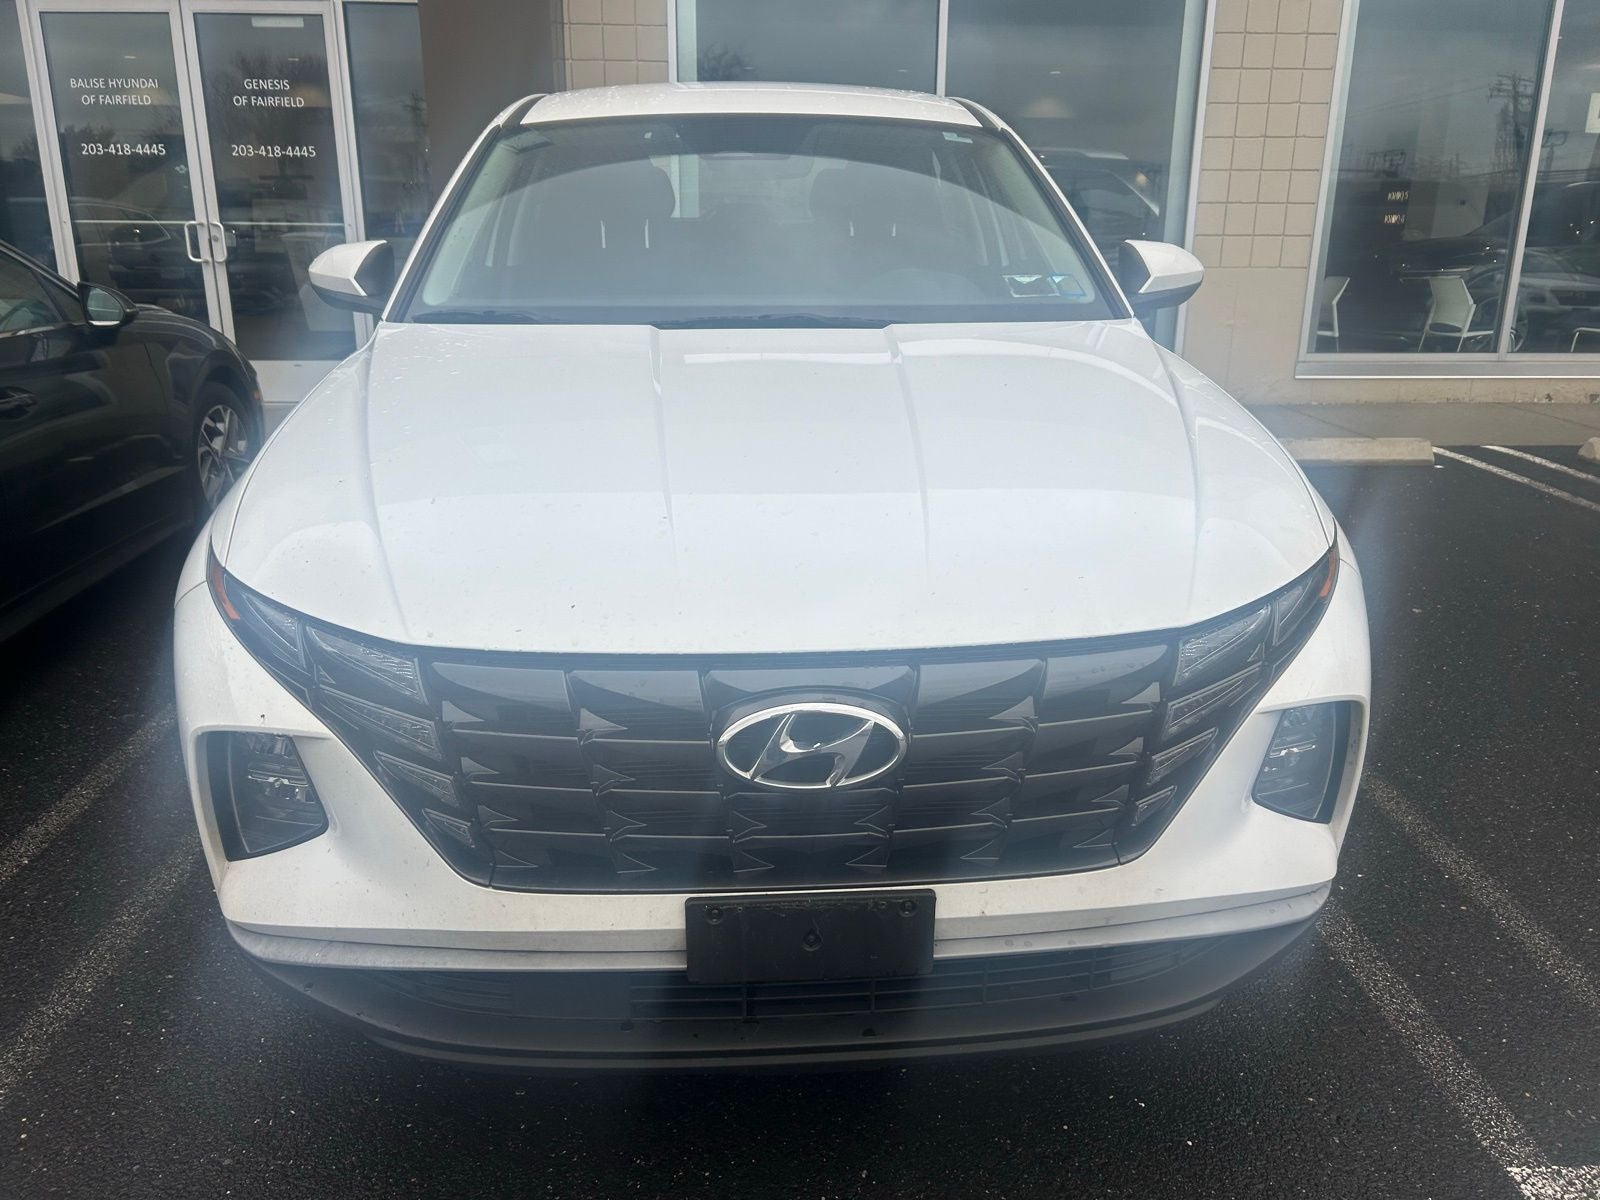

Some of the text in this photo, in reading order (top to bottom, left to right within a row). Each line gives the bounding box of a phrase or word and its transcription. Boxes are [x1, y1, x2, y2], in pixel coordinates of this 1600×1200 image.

[69, 77, 159, 89] BALISE HYUNDAI
[243, 78, 290, 91] GENESIS
[81, 94, 152, 106] OF FAIRFIELD
[232, 95, 305, 108] OF FAIRFIELD
[80, 142, 166, 156] 203-418-4445
[231, 144, 317, 158] 203-418-4445
